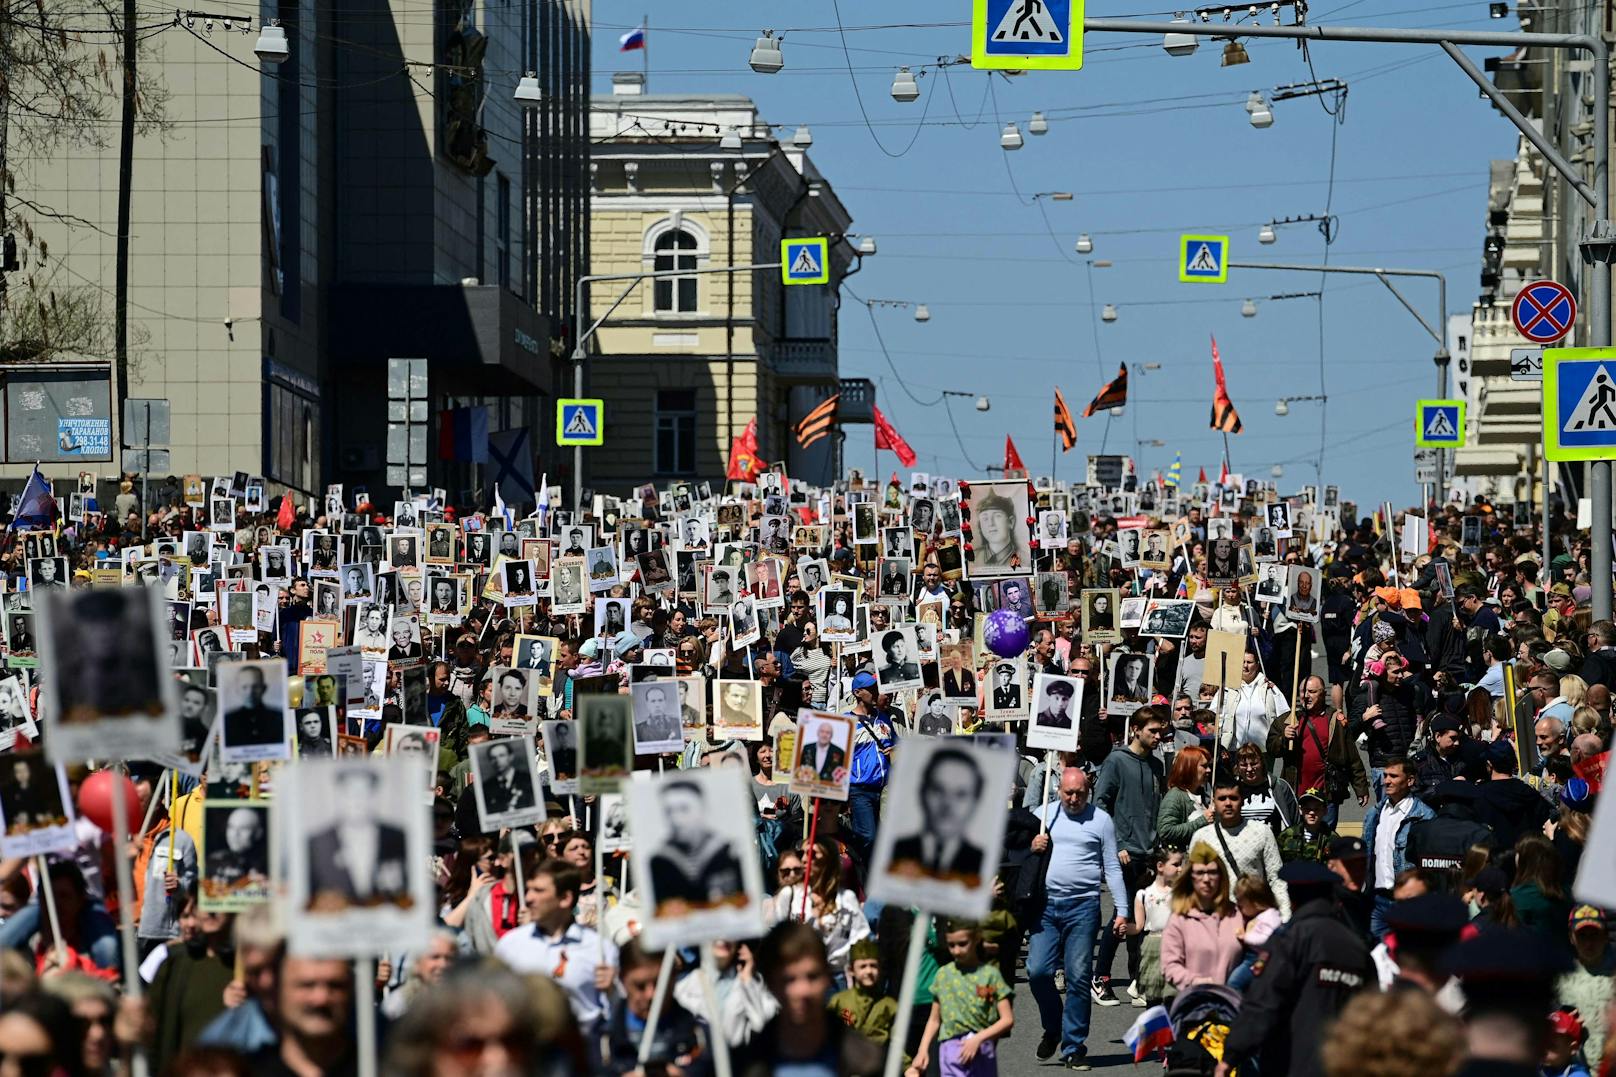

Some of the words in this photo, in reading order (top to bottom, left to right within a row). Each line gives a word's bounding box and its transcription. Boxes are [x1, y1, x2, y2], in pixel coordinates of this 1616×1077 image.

[59, 419, 108, 428] УНИЧТОЖЕНИЕ
[71, 427, 108, 436] ТАРАКАНОВ
[75, 436, 108, 446] 298-31-48
[80, 446, 108, 455] КЛОПОВ
